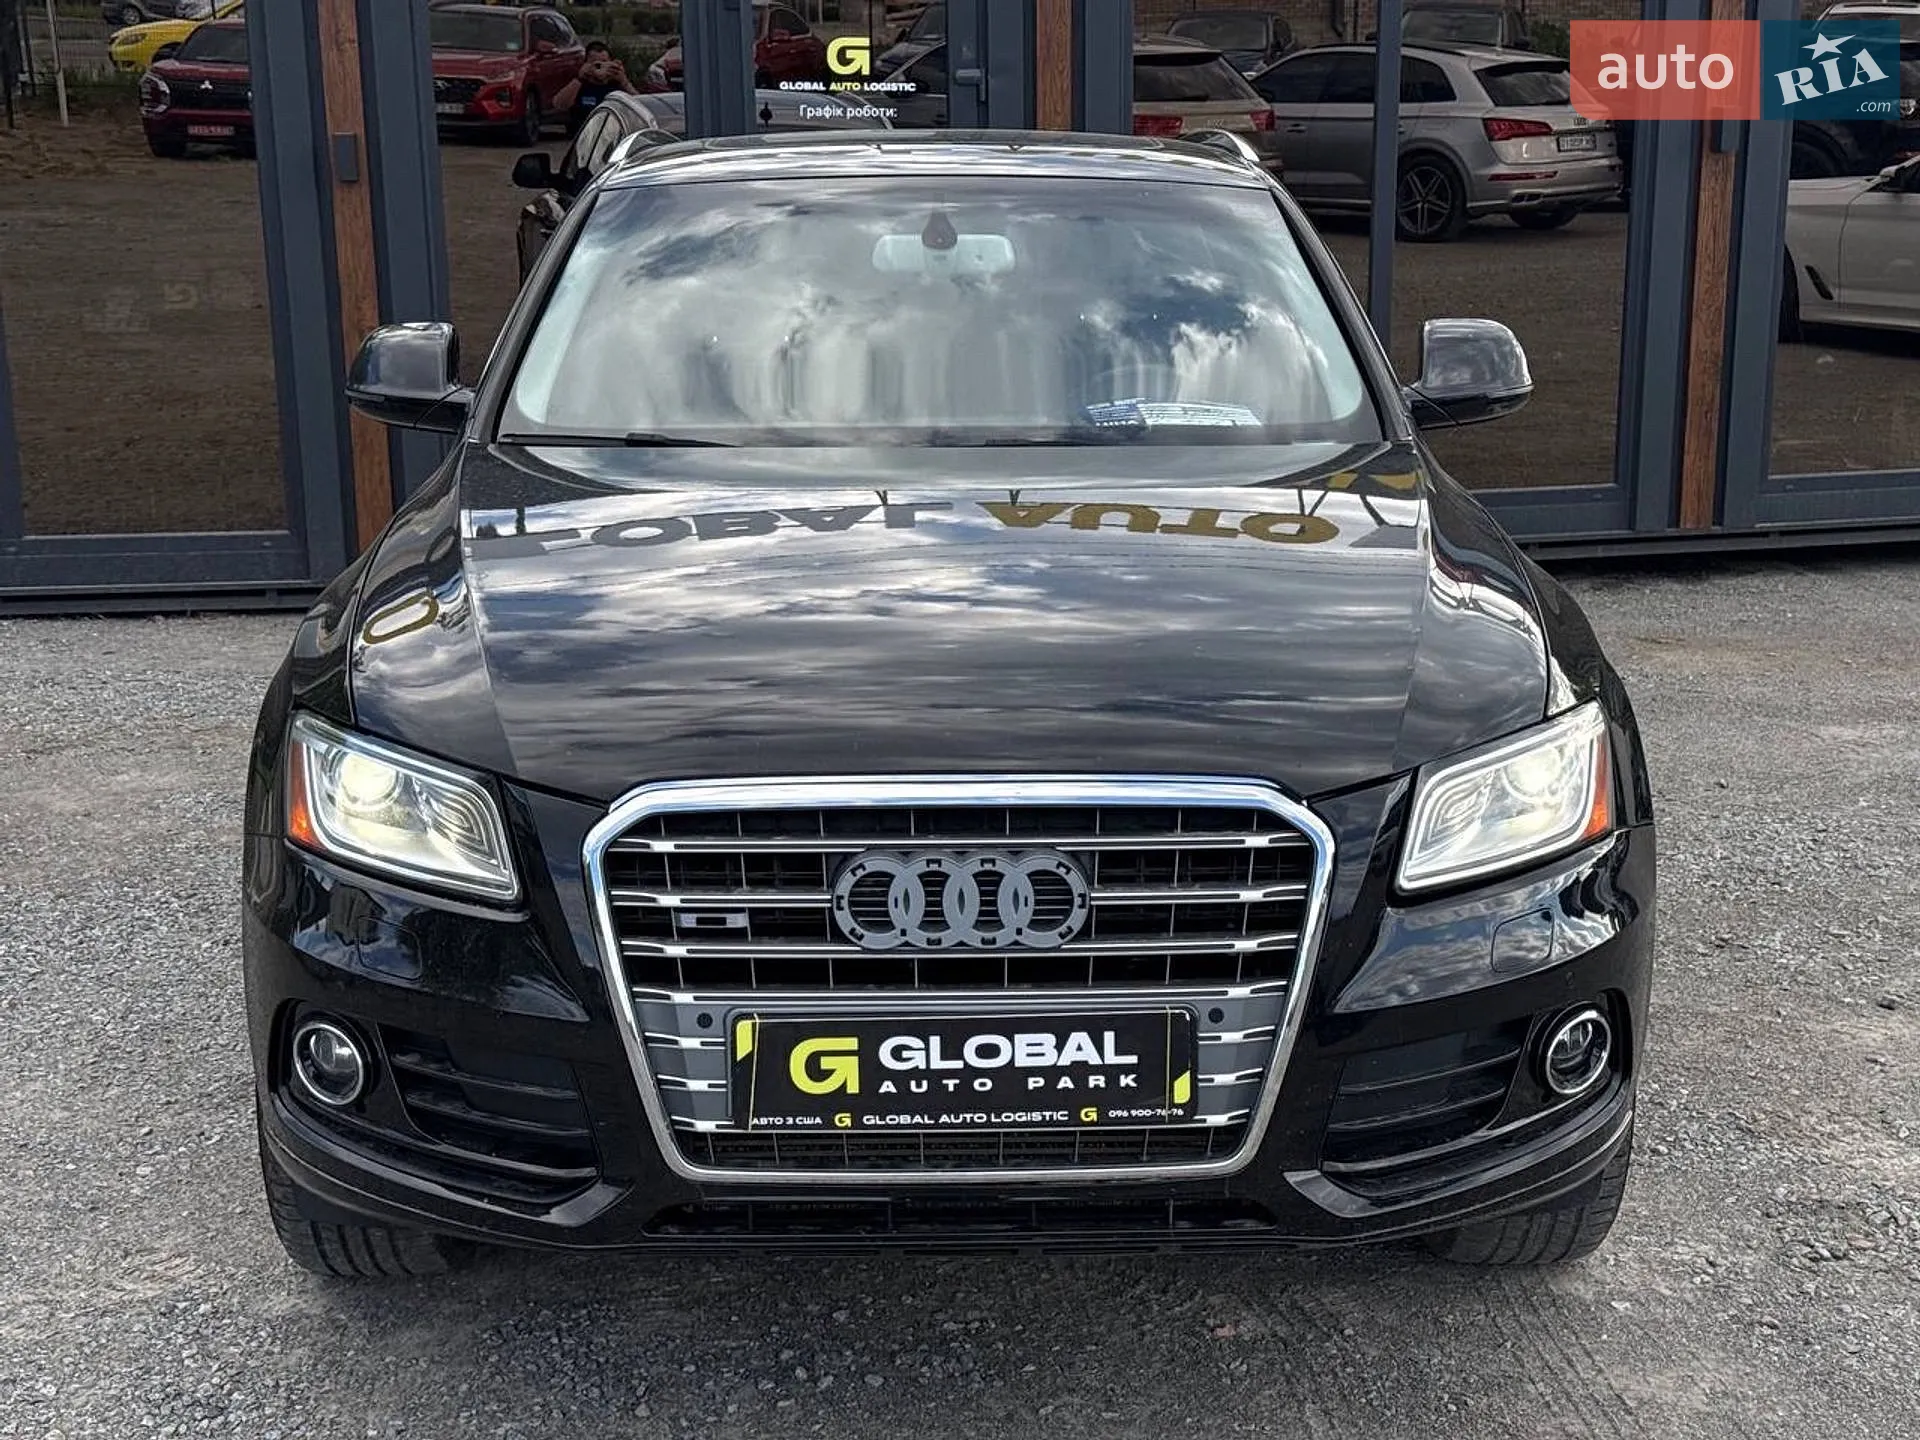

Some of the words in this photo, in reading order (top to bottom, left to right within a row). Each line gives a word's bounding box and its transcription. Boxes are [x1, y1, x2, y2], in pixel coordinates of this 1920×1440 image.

[779, 81, 826, 91] GLOBAL
[829, 82, 861, 91] AUTO
[864, 82, 917, 92] LOGISTIC
[800, 104, 843, 119] Графік
[846, 103, 898, 120] роботи:
[878, 1031, 1139, 1071] GLOBAL
[878, 1078, 993, 1094] AUTO
[1027, 1074, 1138, 1090] PARK
[795, 1116, 823, 1125] США
[862, 1114, 935, 1126] GLOBAL
[938, 1113, 988, 1124] AUTO
[990, 1110, 1069, 1122] LOGISTIC
